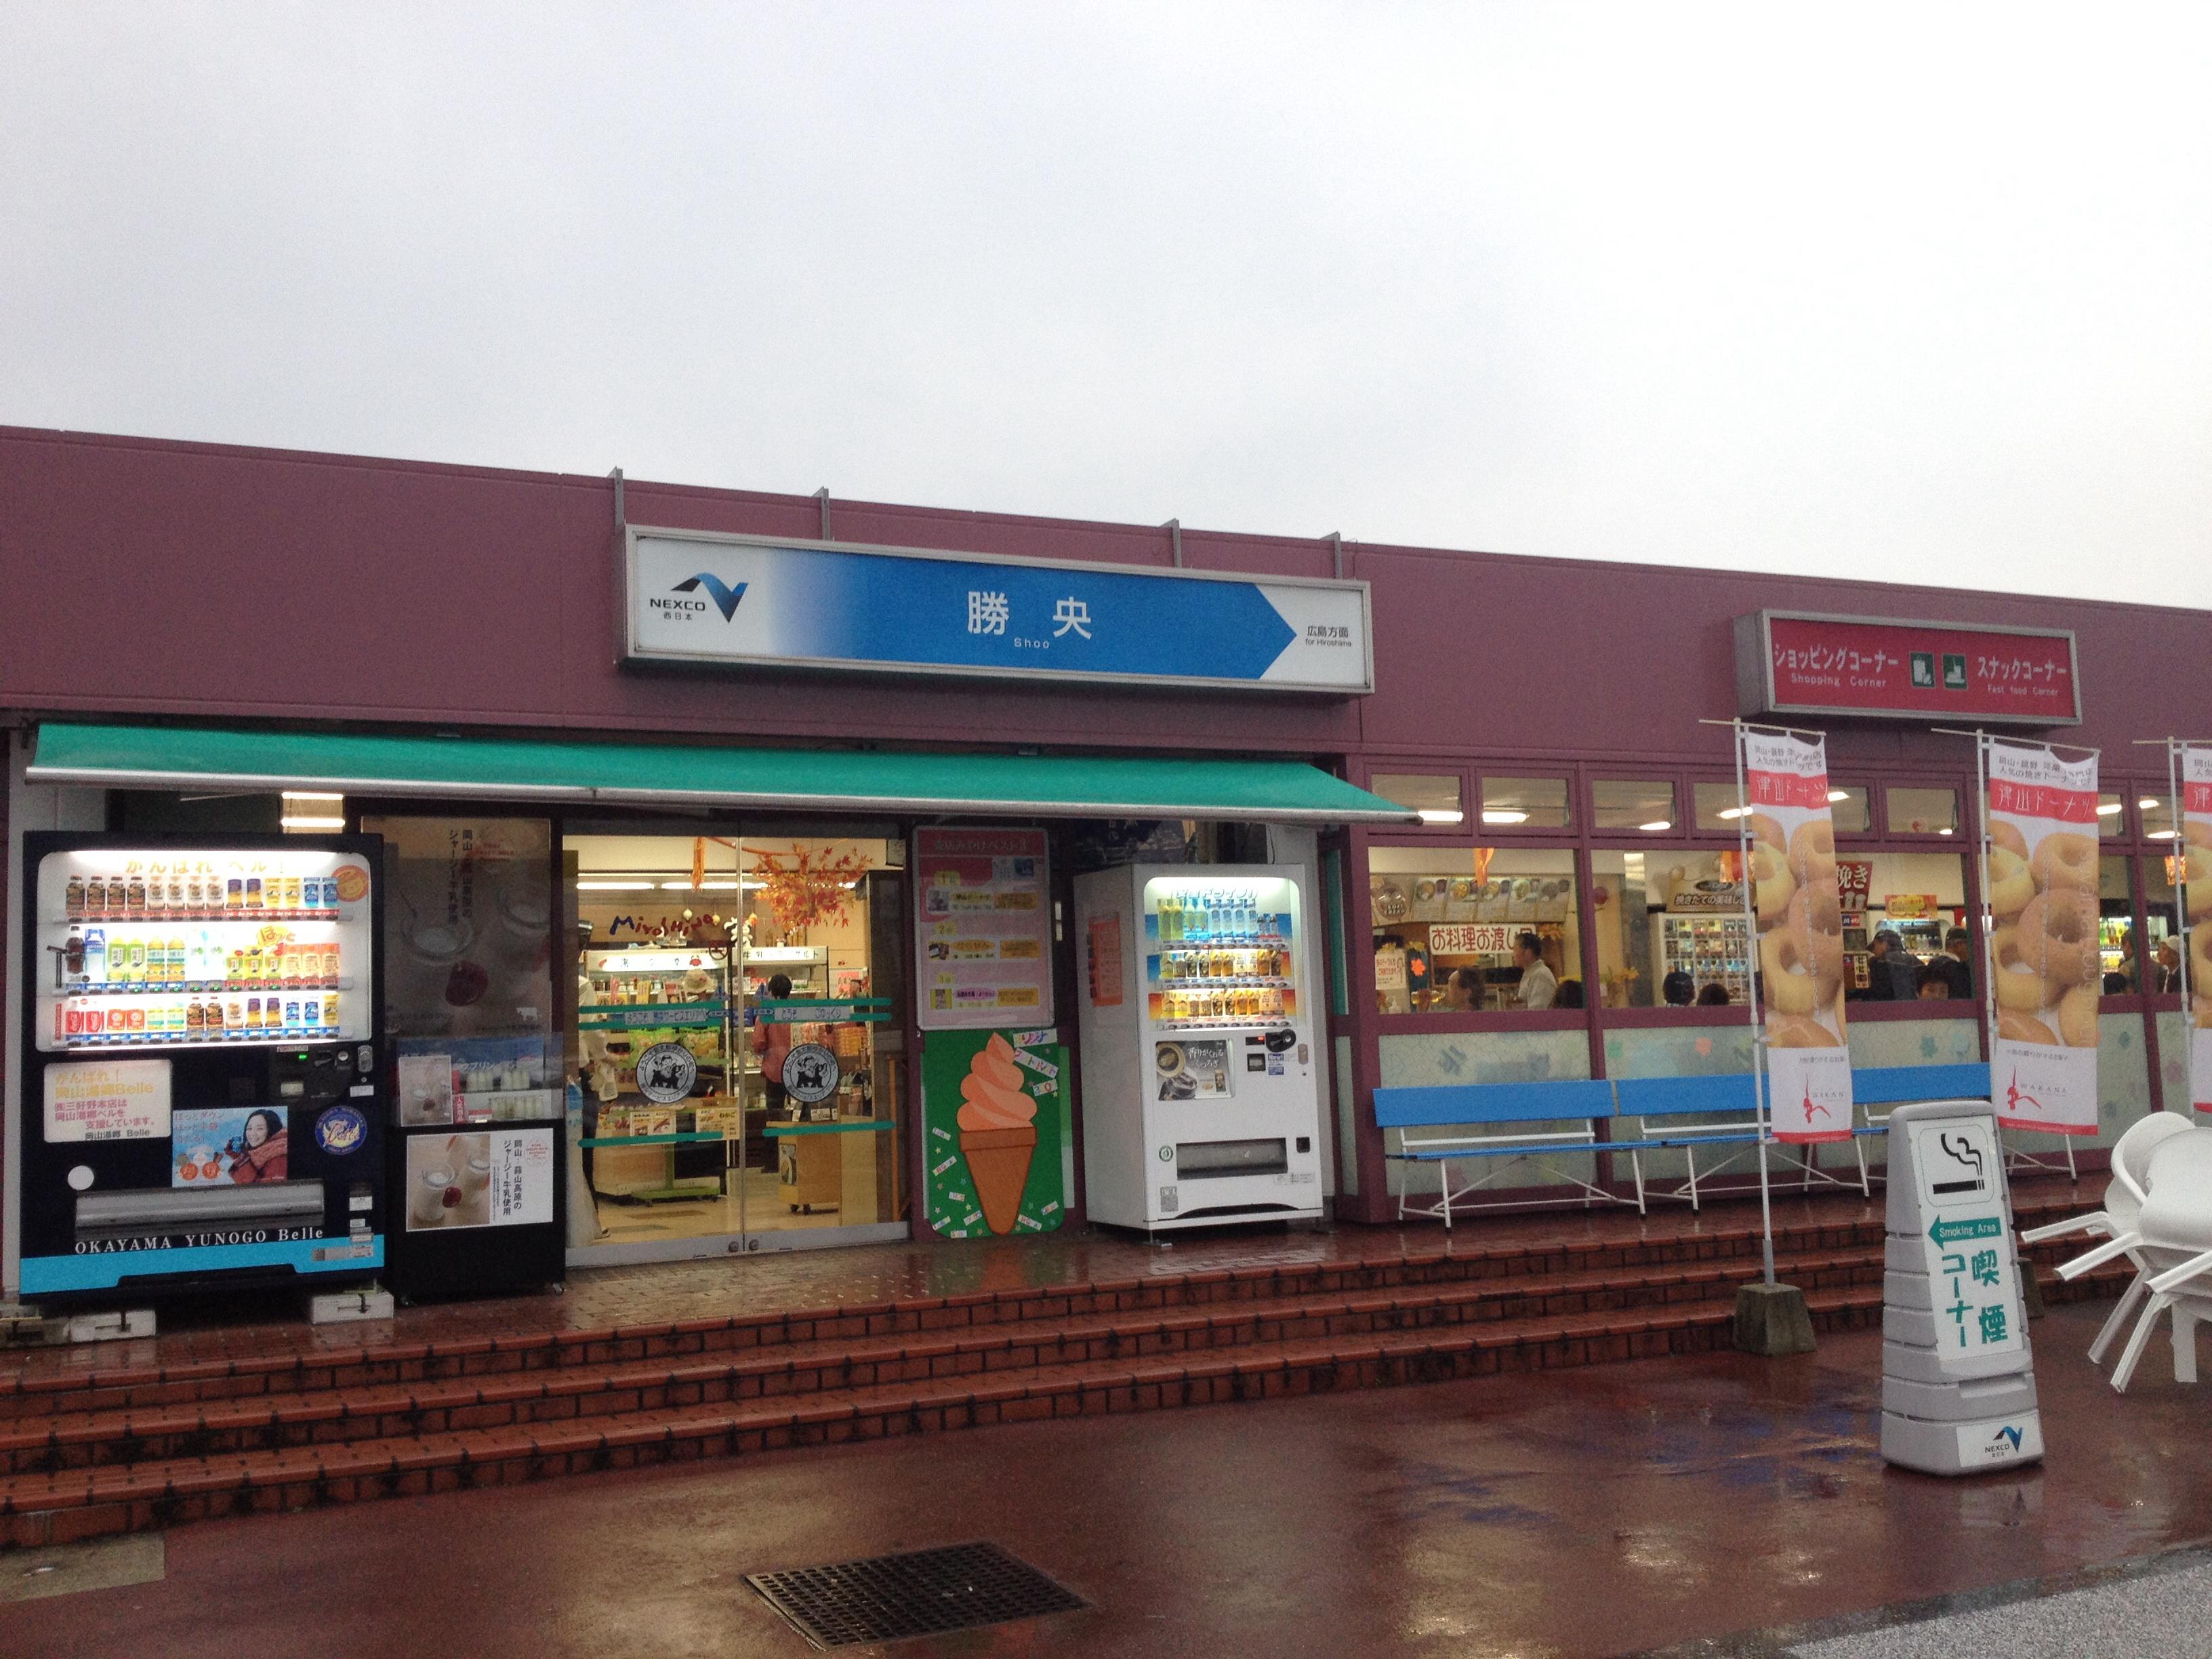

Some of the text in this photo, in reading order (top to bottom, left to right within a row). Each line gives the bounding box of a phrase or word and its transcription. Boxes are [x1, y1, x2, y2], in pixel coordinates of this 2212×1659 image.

[650, 598, 705, 611] NEXCO
[663, 612, 692, 621] 西日本
[968, 590, 1092, 639] 勝央
[1307, 626, 1348, 638] 広島方面
[1014, 637, 1050, 649] Shoo
[1774, 643, 1898, 673] ショッピングコーナー
[1978, 655, 2066, 682] スナックコーナー
[1791, 672, 1887, 687] Shopping Corner
[1999, 784, 2090, 818] 津山ドーナツ
[127, 1129, 150, 1138] Belle
[1939, 1223, 1996, 1237] Smoking Area
[75, 1227, 323, 1254] OKAYAMA YUNOGO Belle
[1942, 1254, 1973, 1347] コーナー
[1971, 1249, 2008, 1345] 喫煙
[1984, 1443, 2009, 1453] NEXCO
